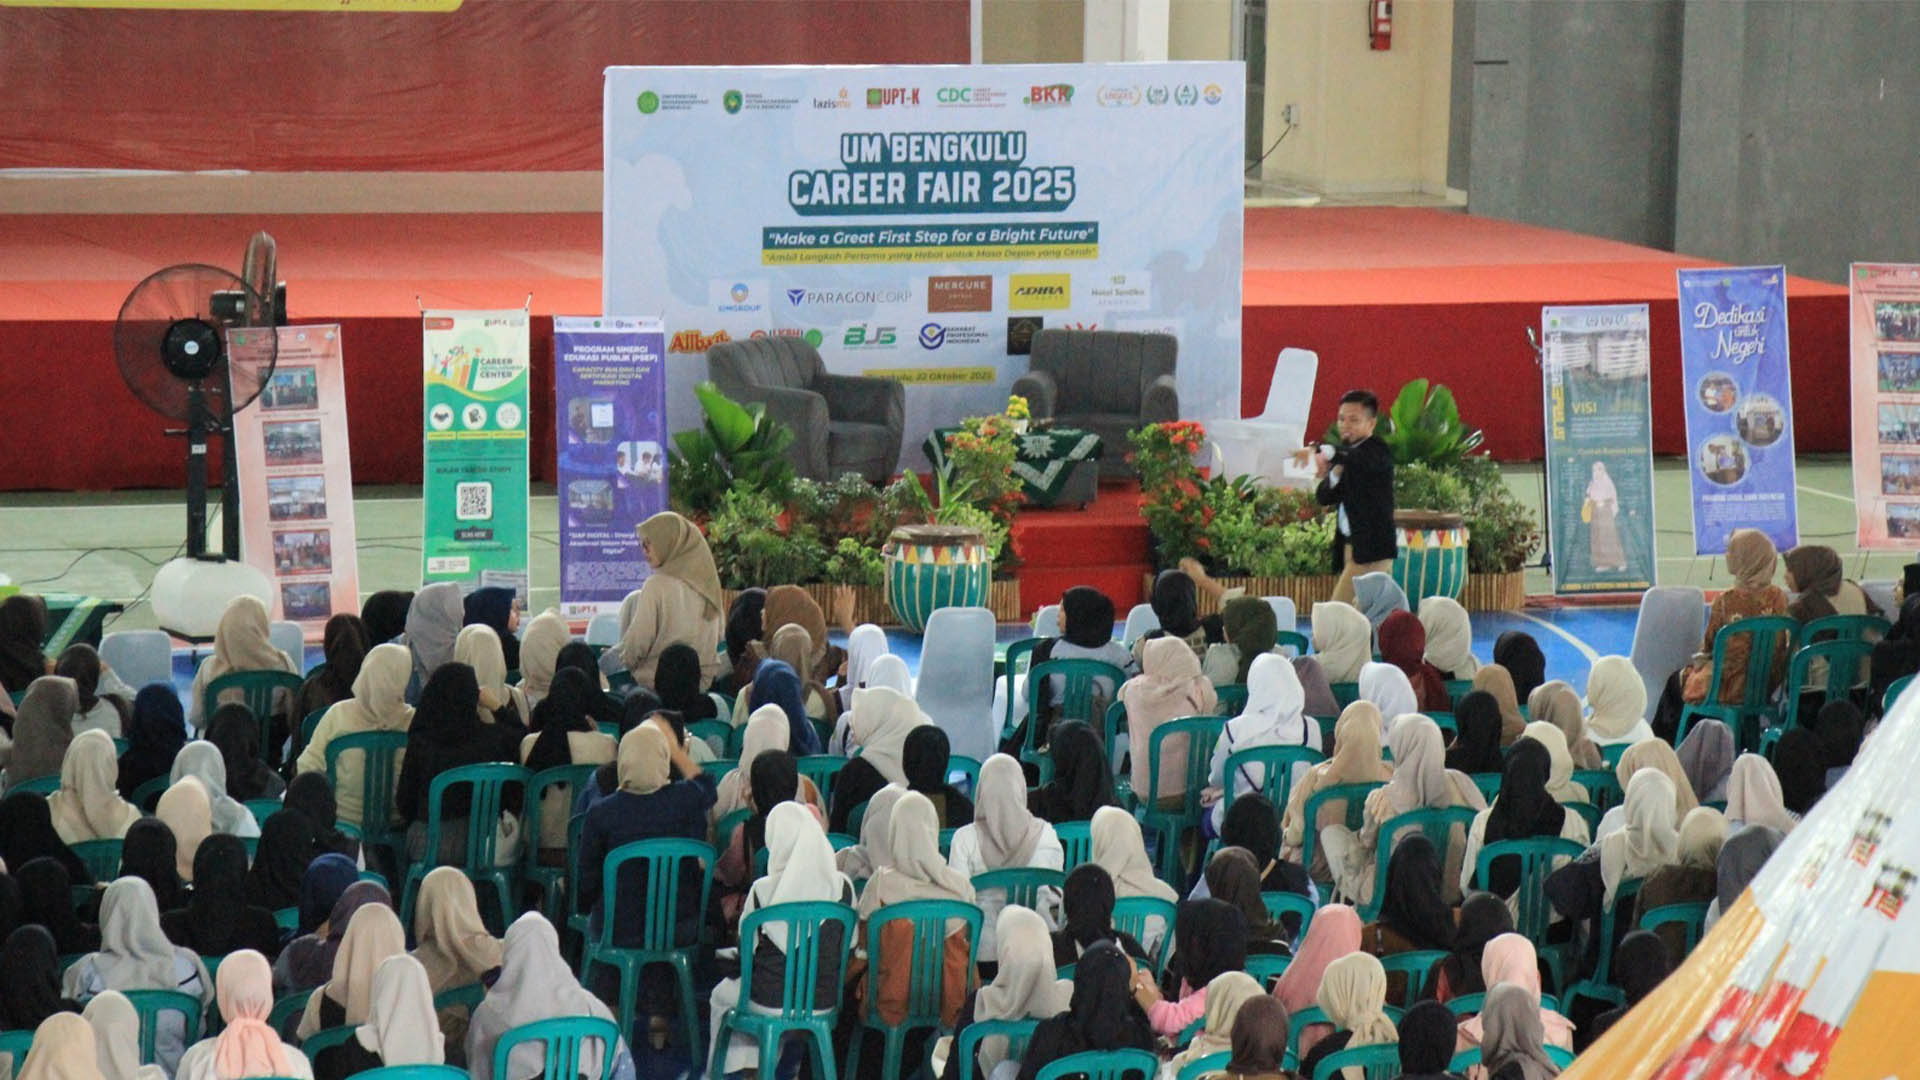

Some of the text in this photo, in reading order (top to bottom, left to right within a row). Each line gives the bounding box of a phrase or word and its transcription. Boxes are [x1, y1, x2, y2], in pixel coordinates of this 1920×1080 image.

[883, 87, 920, 105] UPT-K
[936, 87, 972, 102] CDC
[842, 133, 1024, 163] UM BENGKULU
[791, 167, 1073, 205] CAREER FAIR 2025
[819, 234, 829, 244] a
[833, 231, 875, 244] Great
[878, 230, 911, 243] First
[914, 229, 948, 245] Step
[951, 229, 973, 243] for
[976, 231, 986, 242] a
[989, 227, 1035, 243] Bright
[800, 252, 842, 264] Langkah
[844, 251, 887, 261] Pertama
[888, 251, 912, 263] yang
[914, 249, 944, 259] Hebat
[946, 249, 973, 259] untuk
[976, 248, 1002, 258] Masa
[1004, 248, 1036, 260] Depan
[1038, 248, 1061, 259] yang
[934, 280, 986, 290] MERCURE
[1015, 285, 1064, 295] ADIRA
[1694, 302, 1766, 328] Dedikasi
[843, 325, 897, 345] BJS
[573, 345, 648, 353] PROGRAM SINERGI
[1711, 331, 1766, 364] Negeri
[564, 354, 600, 362] EDUKASI
[929, 371, 967, 381] Oktober
[1571, 402, 1597, 414] VISI
